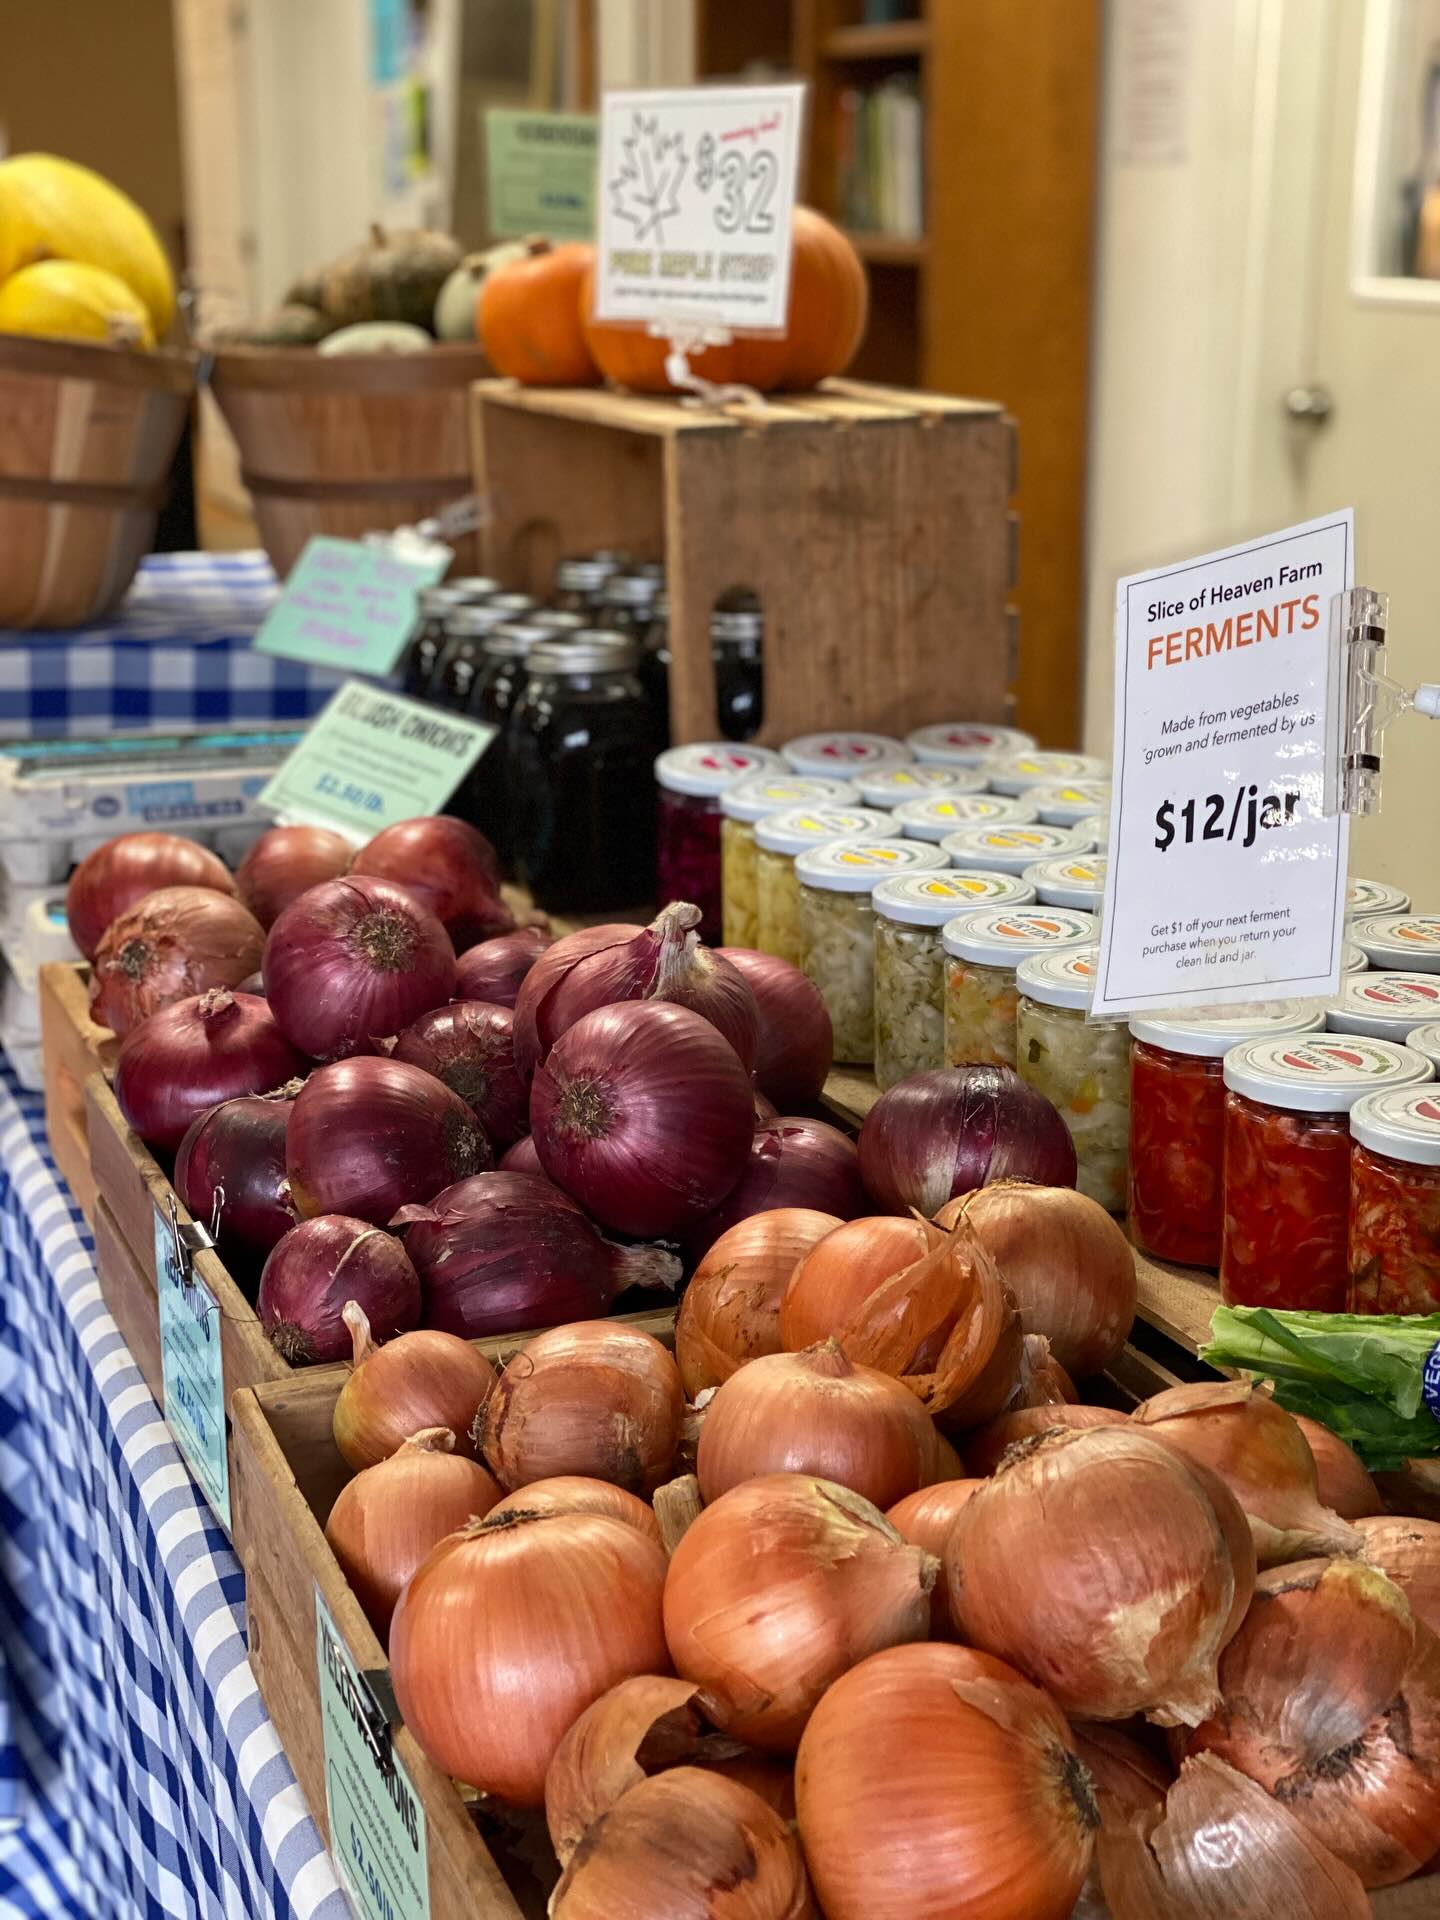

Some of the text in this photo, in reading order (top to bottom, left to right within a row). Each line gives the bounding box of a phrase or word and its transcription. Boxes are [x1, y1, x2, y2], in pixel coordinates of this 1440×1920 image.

[695, 130, 780, 235] $32
[657, 251, 713, 281] MAPLE
[1147, 562, 1323, 622] Slice of Heaven Farm
[1147, 594, 1320, 670] FERMENTS
[400, 712, 476, 758] ONIONS
[1161, 692, 1300, 735] Made from vegetables
[1144, 714, 1316, 764] grown and fermented by us
[1155, 785, 1301, 852] $12/jar
[998, 916, 1059, 940] CURTIDO
[1142, 926, 1297, 958] purchase when you return your
[1151, 907, 1291, 937] Get $1 off your next ferment
[1176, 948, 1257, 968] clean lid and jar.
[1367, 984, 1421, 1004] KIMCHI
[1289, 1050, 1344, 1072] KIMCHI
[1424, 1343, 1440, 1399] VEG
